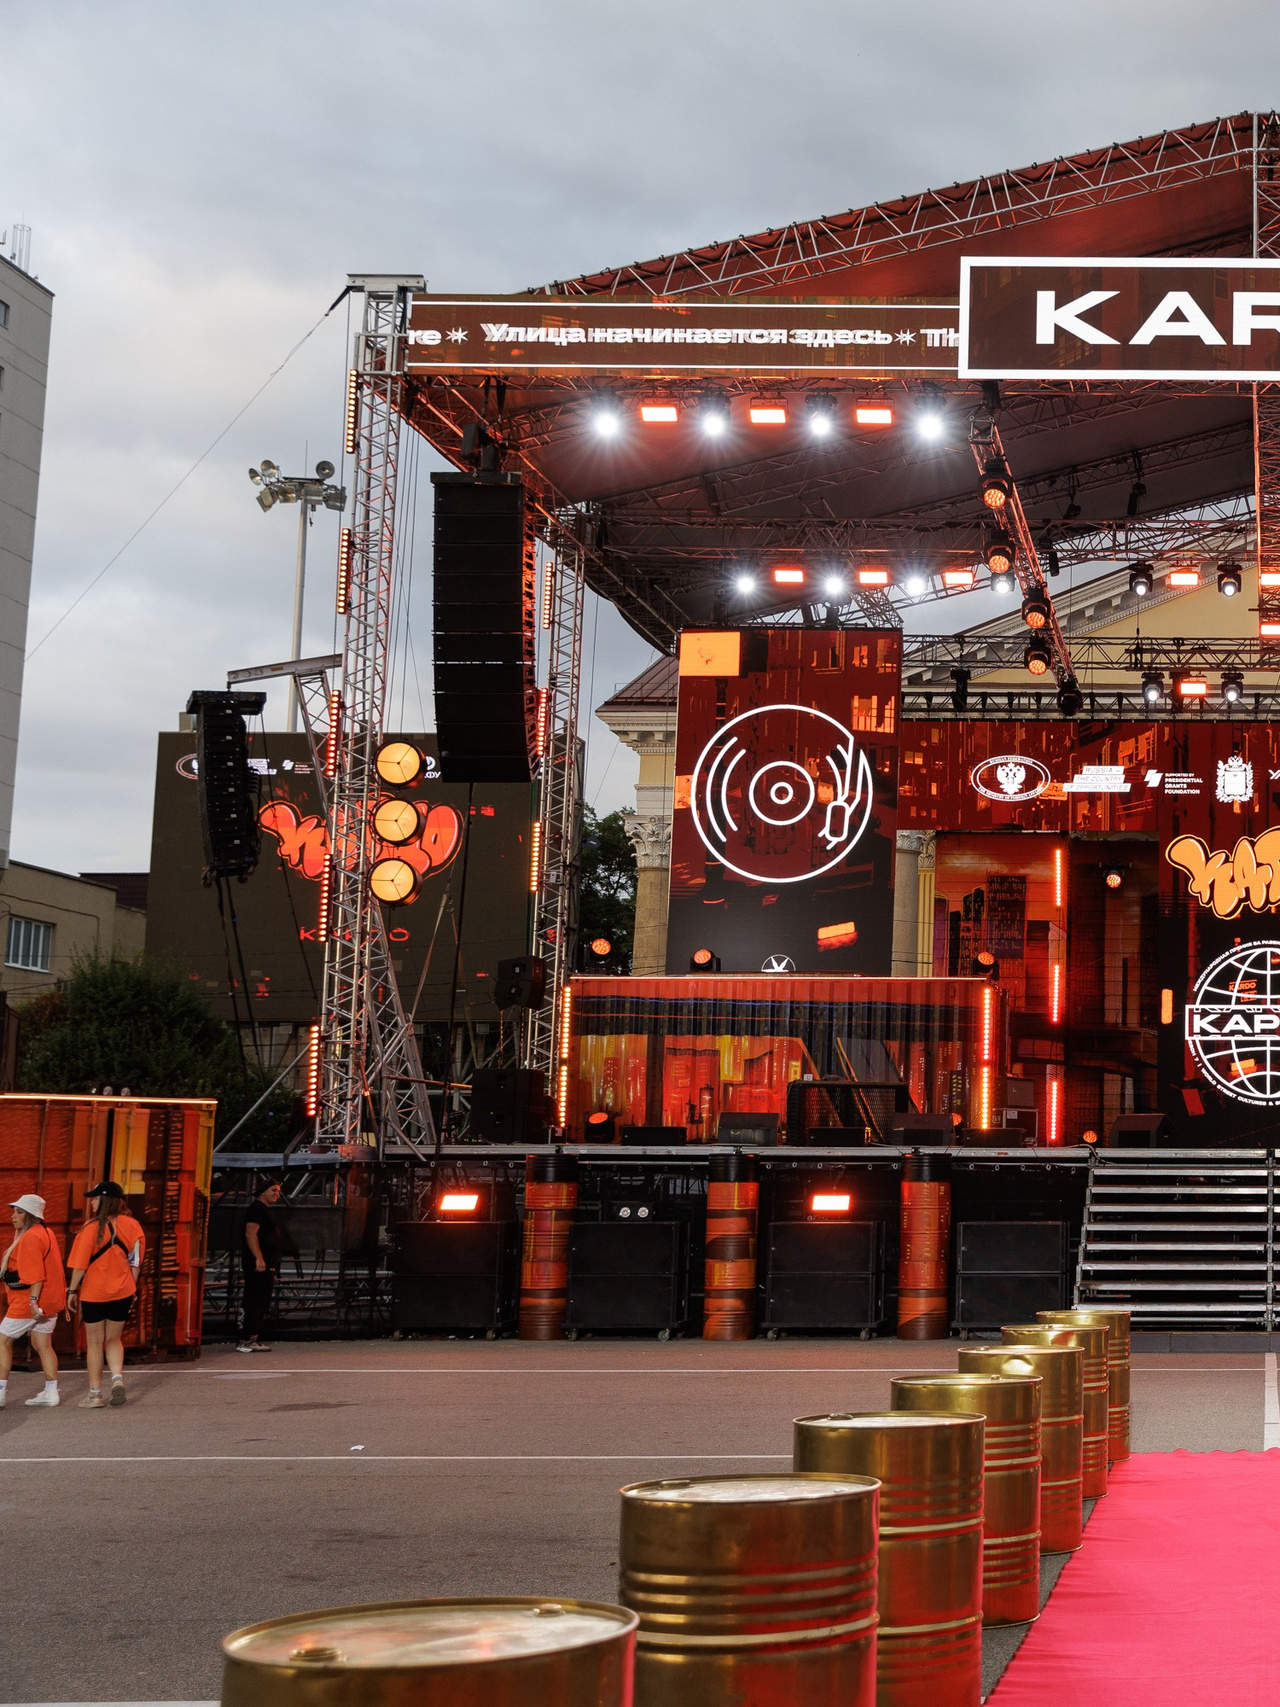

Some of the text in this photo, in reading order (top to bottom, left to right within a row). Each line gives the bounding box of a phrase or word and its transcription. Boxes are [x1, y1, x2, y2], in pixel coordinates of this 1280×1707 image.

[480, 323, 893, 348] Улица начинается здесь
[1237, 1096, 1267, 1106] CULTURES
